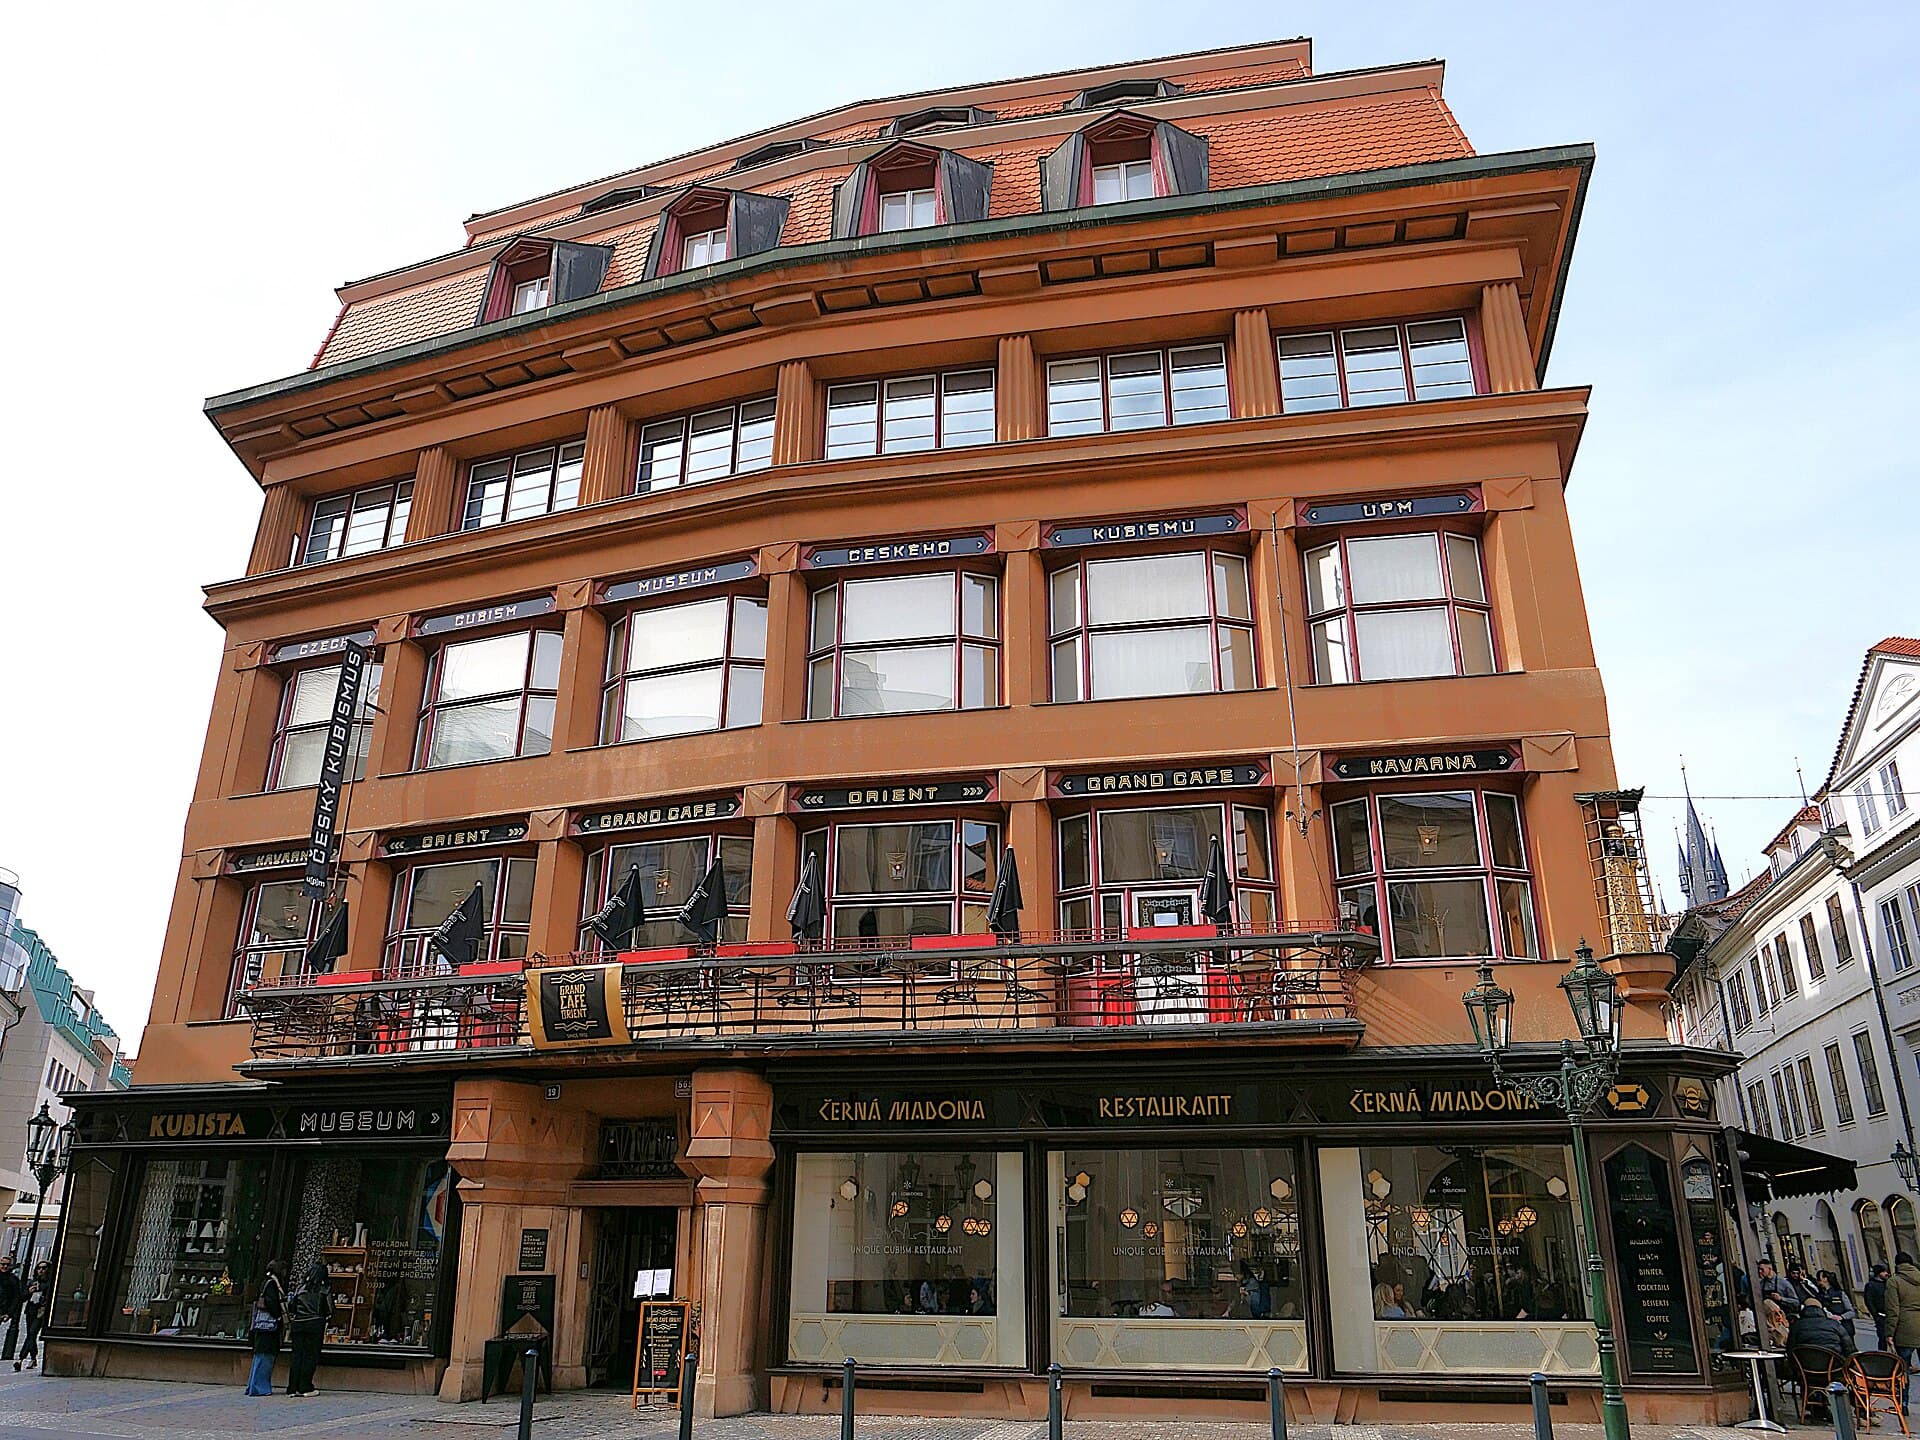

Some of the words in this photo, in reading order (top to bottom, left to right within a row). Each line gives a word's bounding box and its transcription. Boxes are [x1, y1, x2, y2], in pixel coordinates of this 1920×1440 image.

[1362, 501, 1414, 518] UPM
[1093, 519, 1196, 541] KUBISMU
[637, 567, 718, 593] MUSEUM
[454, 604, 518, 627] CUBISM
[325, 650, 361, 774] KUBISMUS
[1087, 772, 1165, 791] GRAND
[1173, 768, 1234, 786] CAFE
[848, 786, 939, 805] ORIENT
[599, 808, 662, 829] GRAND
[667, 802, 718, 821] CAFE
[421, 829, 490, 849] ORIENT
[559, 983, 587, 996] GRAND
[559, 994, 588, 1010] CAFE
[560, 1007, 588, 1020] ORIENT
[818, 1098, 881, 1121] ČERNÁ
[888, 1099, 986, 1121] MADONA
[1099, 1094, 1232, 1118] RESTAURANT
[1349, 1088, 1422, 1113] ČERNÁ
[1430, 1090, 1541, 1112] MADONA
[149, 1112, 246, 1137] KUBISTA
[300, 1109, 415, 1132] MUSEUM
[850, 1245, 880, 1255] UNIQUE
[883, 1245, 912, 1255] CUBISM
[914, 1245, 963, 1255] RESTAURANT
[1113, 1246, 1145, 1256] UNIQUE
[1182, 1246, 1229, 1256] RESTAURAN
[1466, 1245, 1521, 1256] RESTAURANT
[1638, 1268, 1664, 1276] DINNER
[1637, 1283, 1670, 1292] COCKTAILS
[1642, 1299, 1670, 1308] DESSERTS
[1646, 1315, 1670, 1323] COFFEE
